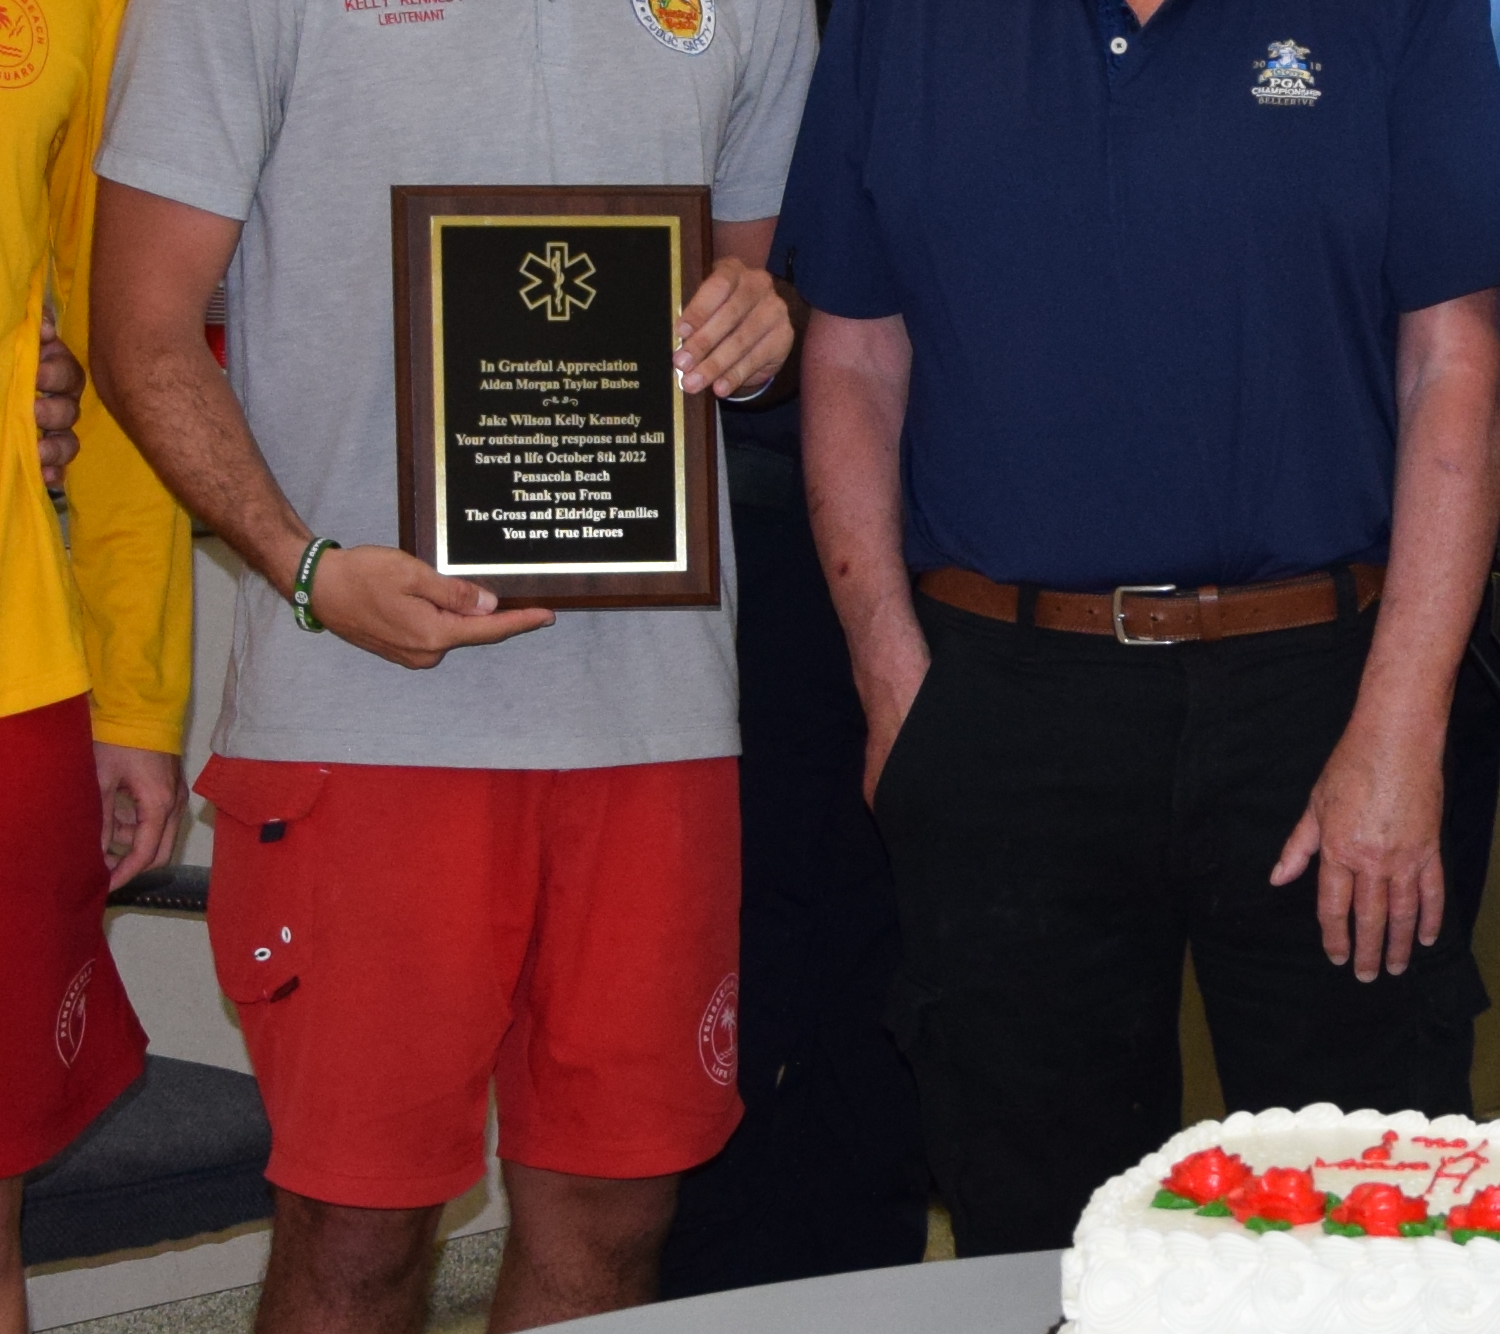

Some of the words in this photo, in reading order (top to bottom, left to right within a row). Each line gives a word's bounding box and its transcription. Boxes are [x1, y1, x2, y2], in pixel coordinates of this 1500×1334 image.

[378, 9, 445, 26] LIEUTENANT
[643, 16, 679, 47] PUBLIC
[682, 26, 712, 51] SAFETY
[1269, 78, 1306, 88] PGA
[1251, 86, 1322, 97] CHAMPIONSHIP
[1258, 97, 1315, 106] BELLERIVE
[480, 359, 494, 372] In
[498, 359, 553, 372] Grateful
[556, 359, 637, 375] Appreciation
[479, 378, 513, 389] Aiden
[515, 378, 560, 391] Morgan
[562, 378, 597, 391] Taylor
[600, 377, 639, 389] Busbee
[478, 414, 507, 426] Jake
[510, 414, 551, 425] Wilson
[554, 413, 586, 428] Kelly
[589, 413, 640, 427] Kennedy
[455, 433, 486, 445] Your
[488, 433, 558, 447] outstanding
[561, 435, 612, 447] response
[615, 432, 636, 443] and
[640, 431, 664, 443] skill
[474, 452, 510, 464] Saved
[514, 454, 521, 463] a
[524, 451, 543, 463] life
[545, 451, 594, 463] October
[596, 451, 616, 462] 8th
[619, 450, 646, 462] 2022
[513, 470, 571, 482] Pensacola
[574, 469, 610, 481] Beach
[511, 489, 552, 501] Thank
[554, 491, 576, 503] you
[579, 488, 611, 500] From
[464, 509, 489, 521] The
[491, 508, 526, 520] Gross
[529, 507, 552, 519] and
[555, 507, 606, 521] Eldridge
[609, 506, 658, 518] Families
[502, 527, 526, 539] You
[529, 529, 548, 538] are
[554, 528, 579, 538] true
[582, 526, 623, 537] Heroes
